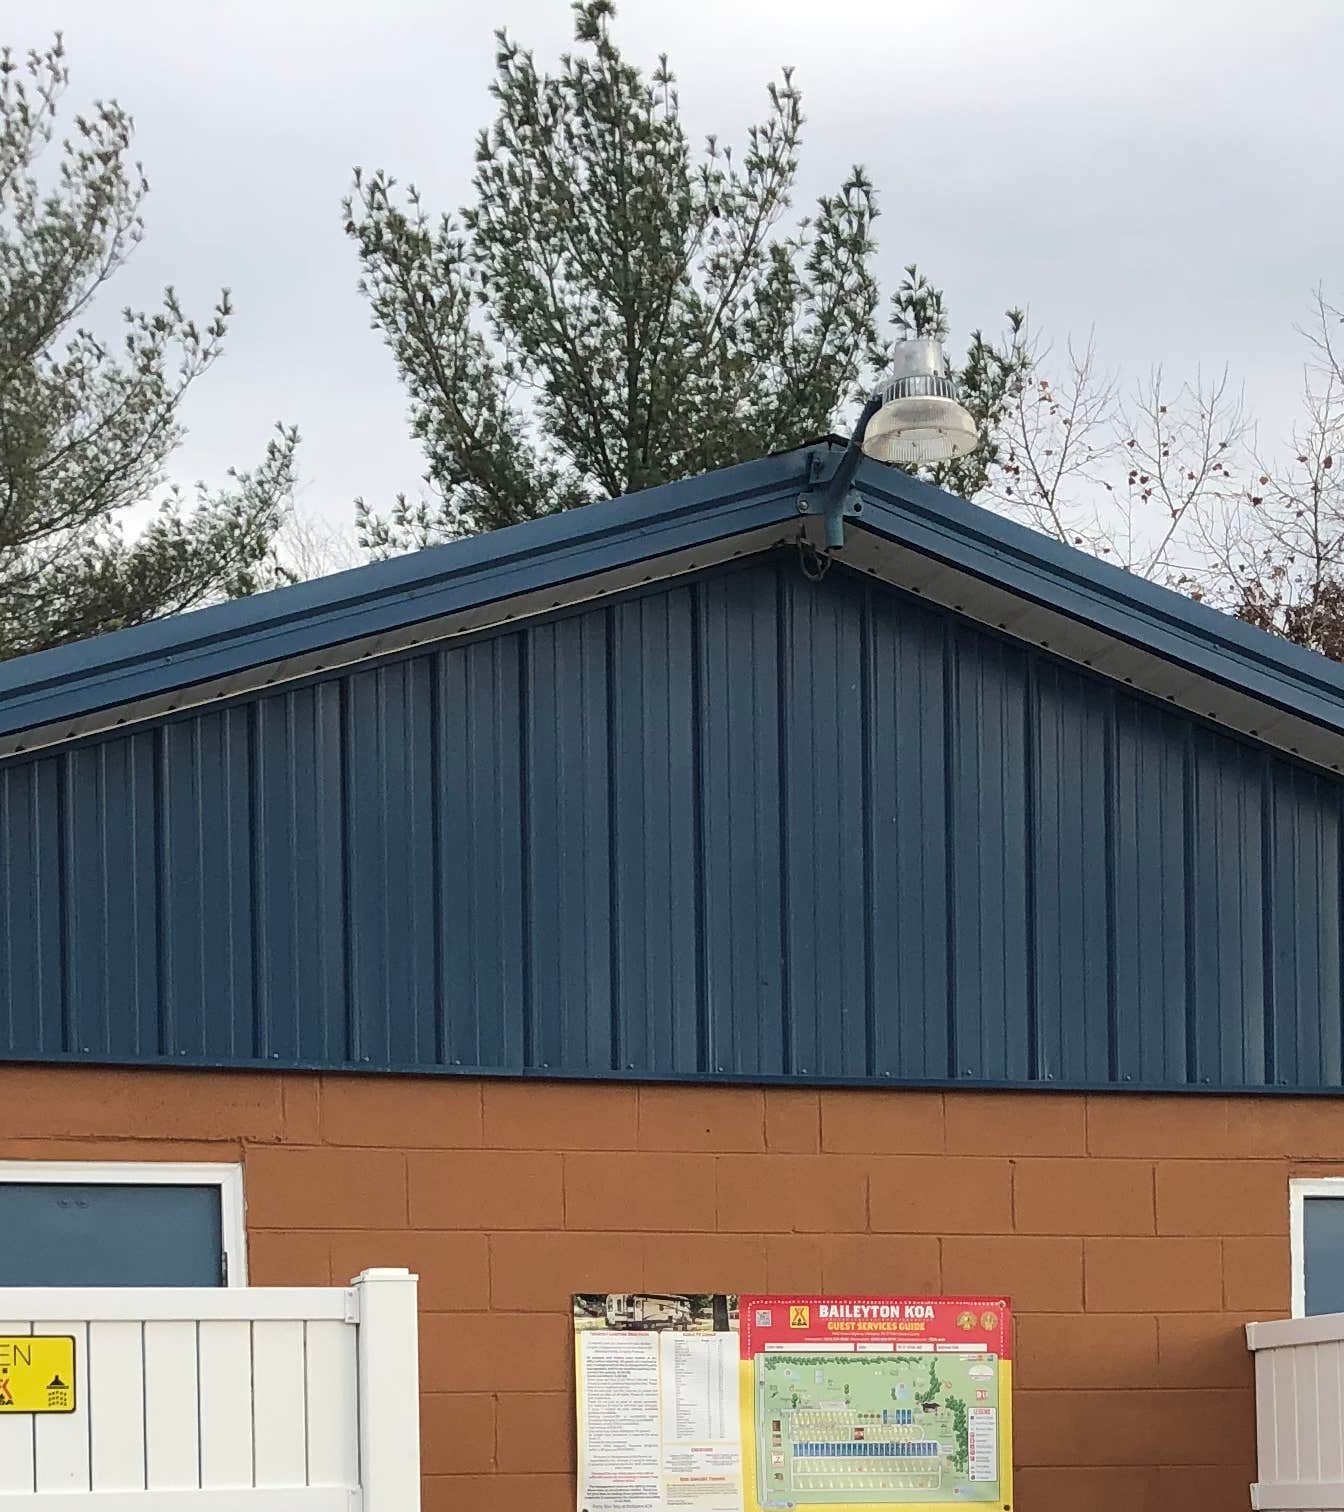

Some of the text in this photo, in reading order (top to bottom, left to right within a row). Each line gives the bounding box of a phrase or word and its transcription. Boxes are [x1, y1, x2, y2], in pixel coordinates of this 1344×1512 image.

[819, 1304, 934, 1319] BAILEYTON KOA
[827, 1321, 925, 1331] GUEST SERVICES GUIDE
